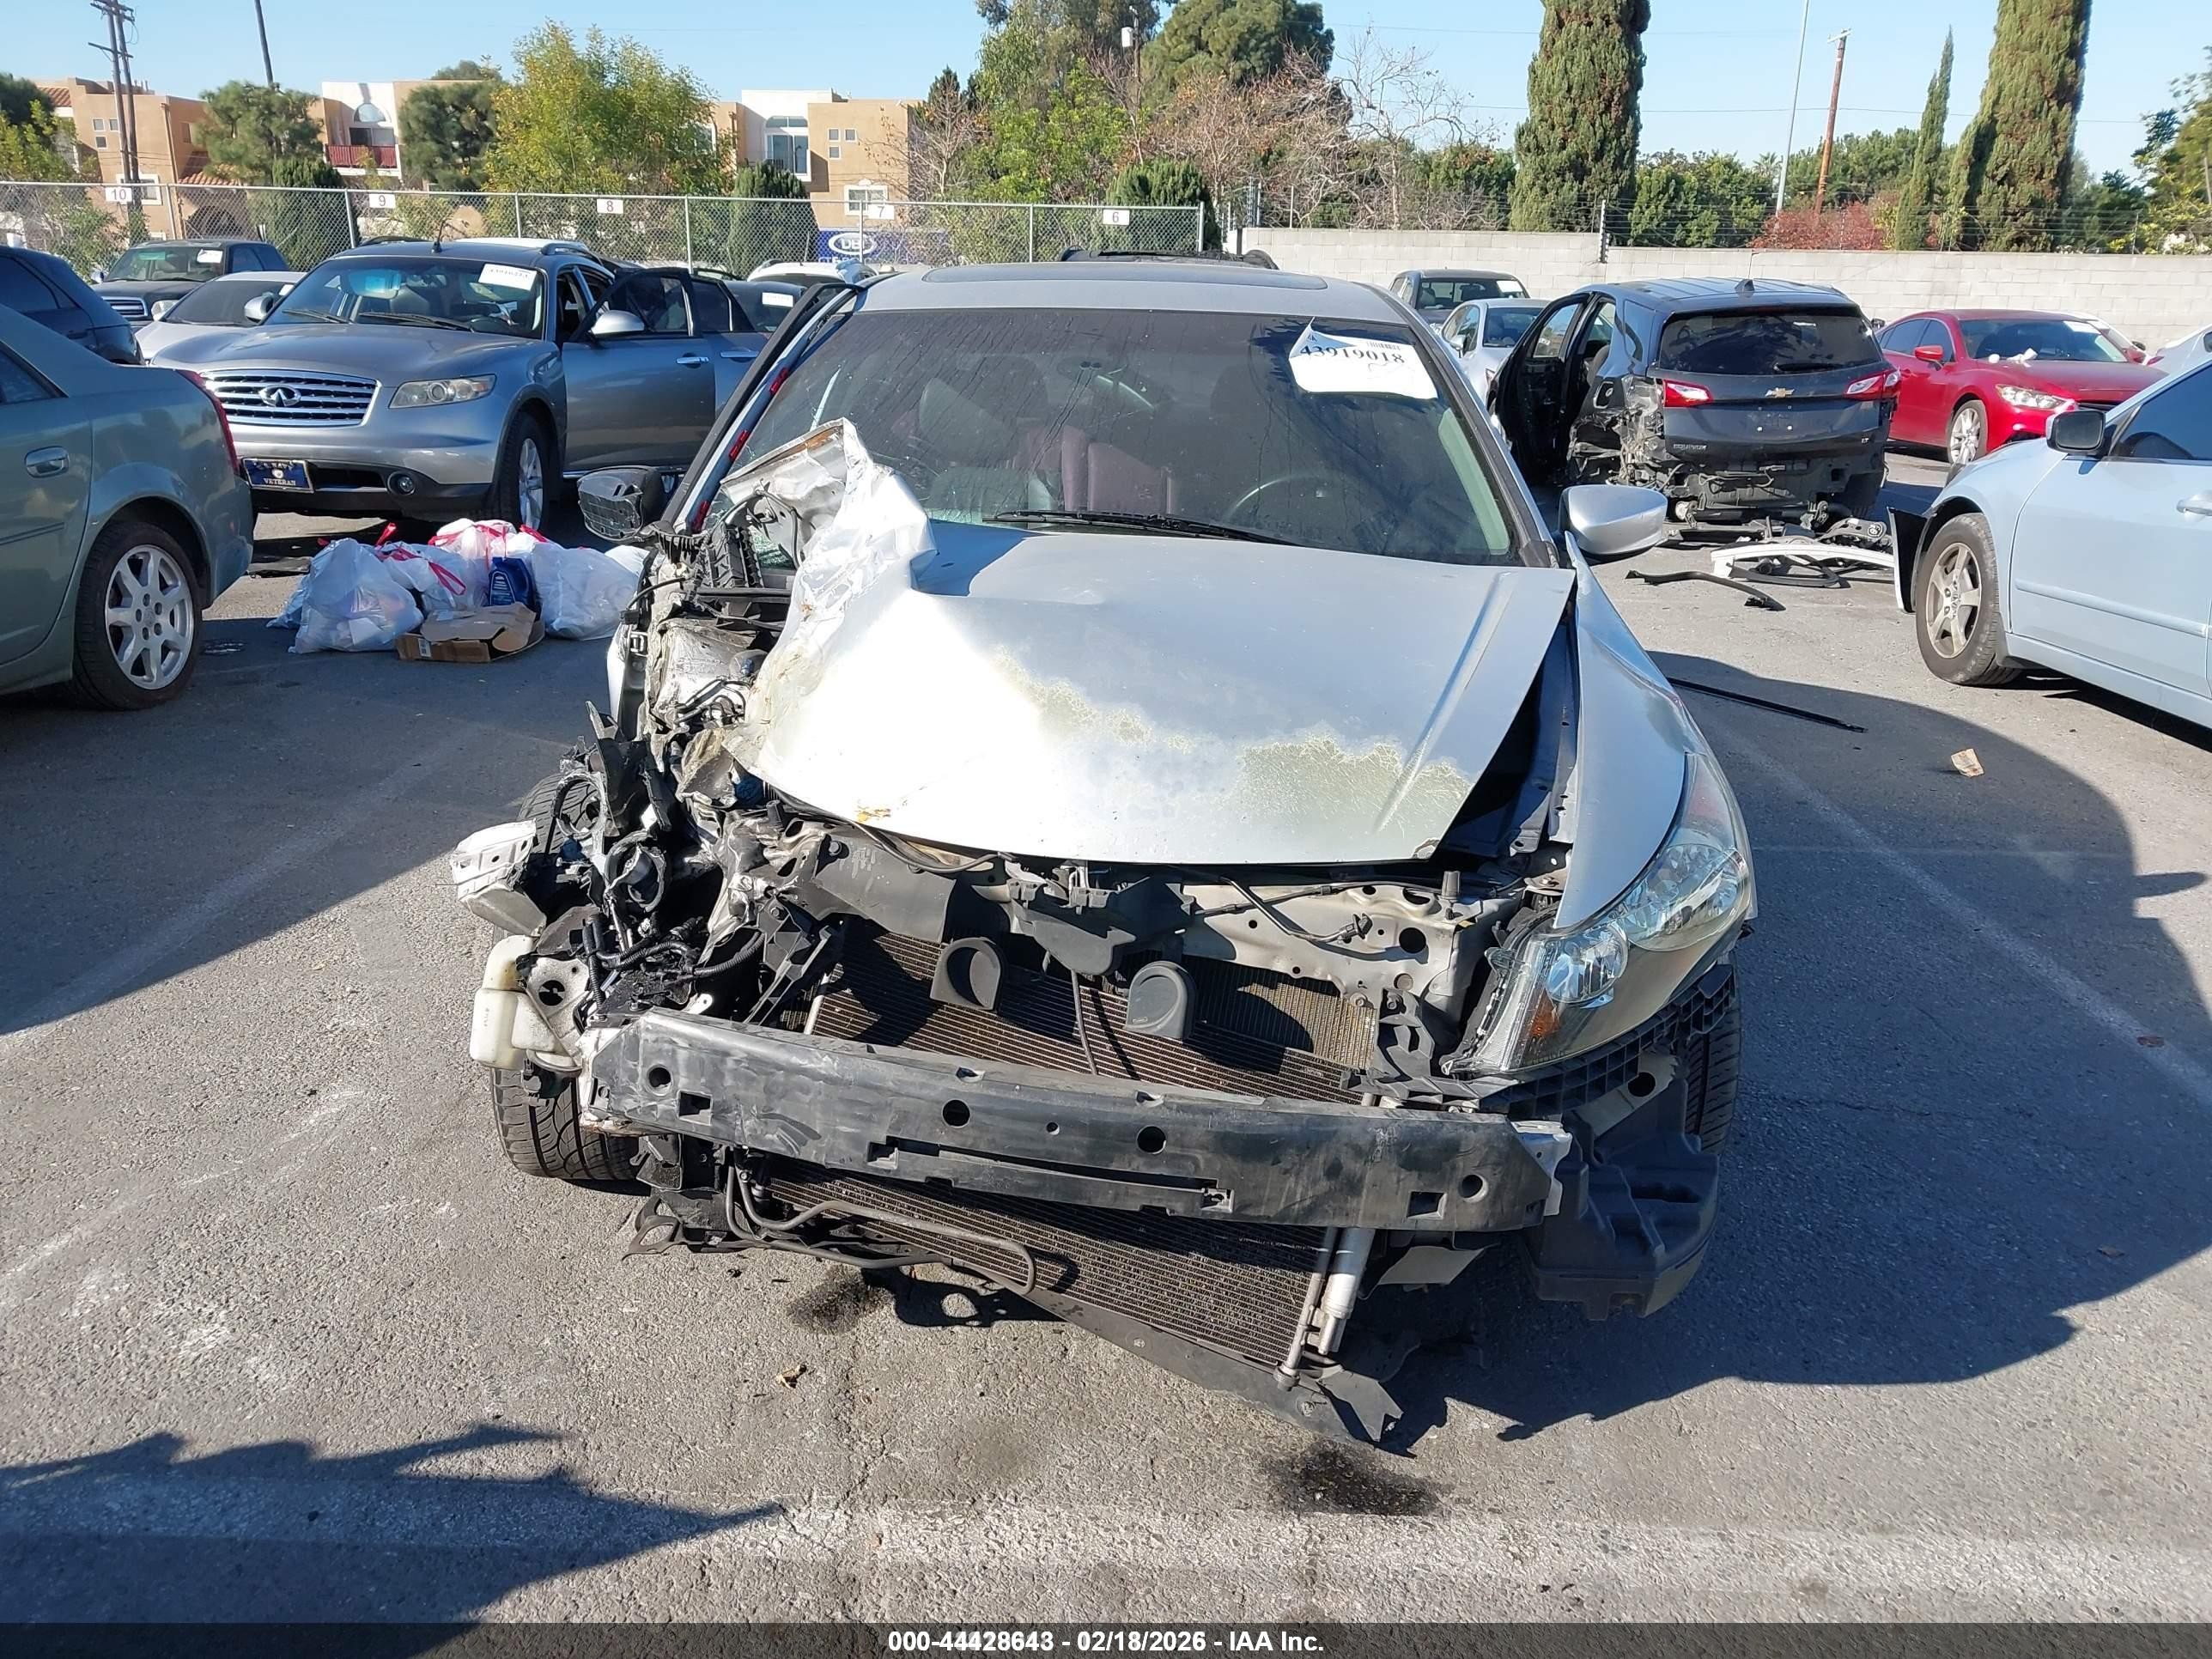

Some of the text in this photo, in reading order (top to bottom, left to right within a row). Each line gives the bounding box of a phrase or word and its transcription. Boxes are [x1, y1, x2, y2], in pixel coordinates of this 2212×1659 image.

[112, 188, 127, 201] 10
[379, 194, 386, 207] 9
[606, 200, 614, 213] 8
[877, 205, 884, 218] 7
[1112, 211, 1120, 223] 6
[1300, 344, 1406, 364] 43919018
[263, 477, 296, 486] VETERAN
